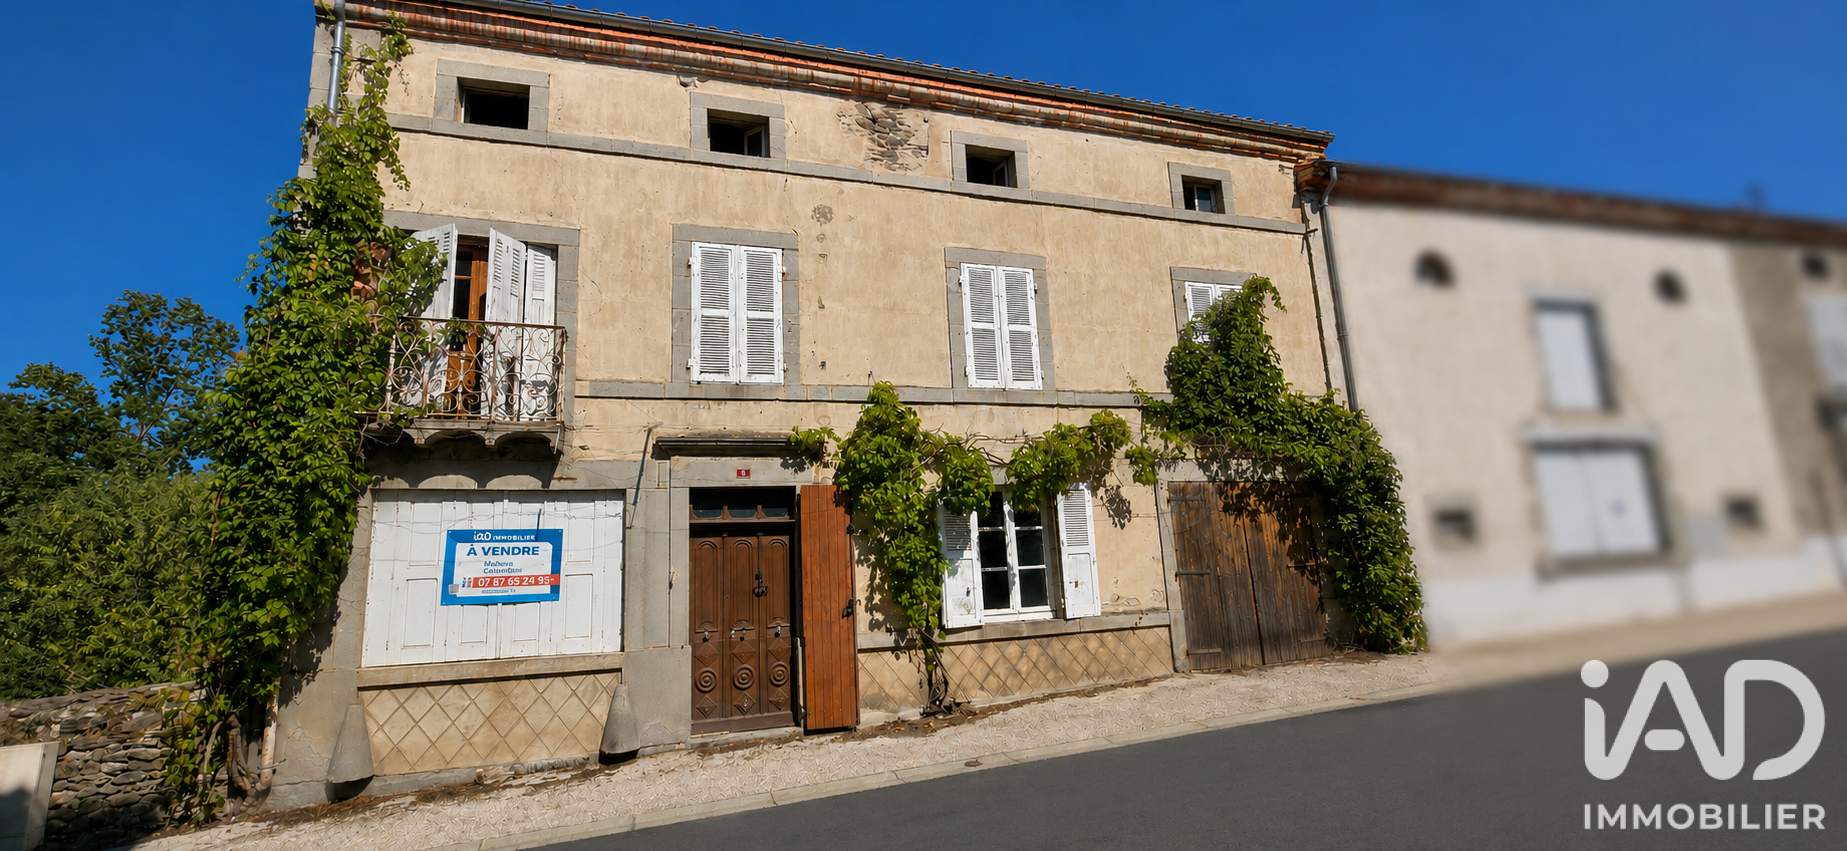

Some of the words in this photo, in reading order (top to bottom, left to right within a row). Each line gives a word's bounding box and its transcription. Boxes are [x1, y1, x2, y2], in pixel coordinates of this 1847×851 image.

[466, 544, 478, 556] À
[481, 546, 540, 556] VENDRE
[478, 578, 491, 587] 07
[507, 577, 520, 586] 65
[522, 576, 535, 585] 24
